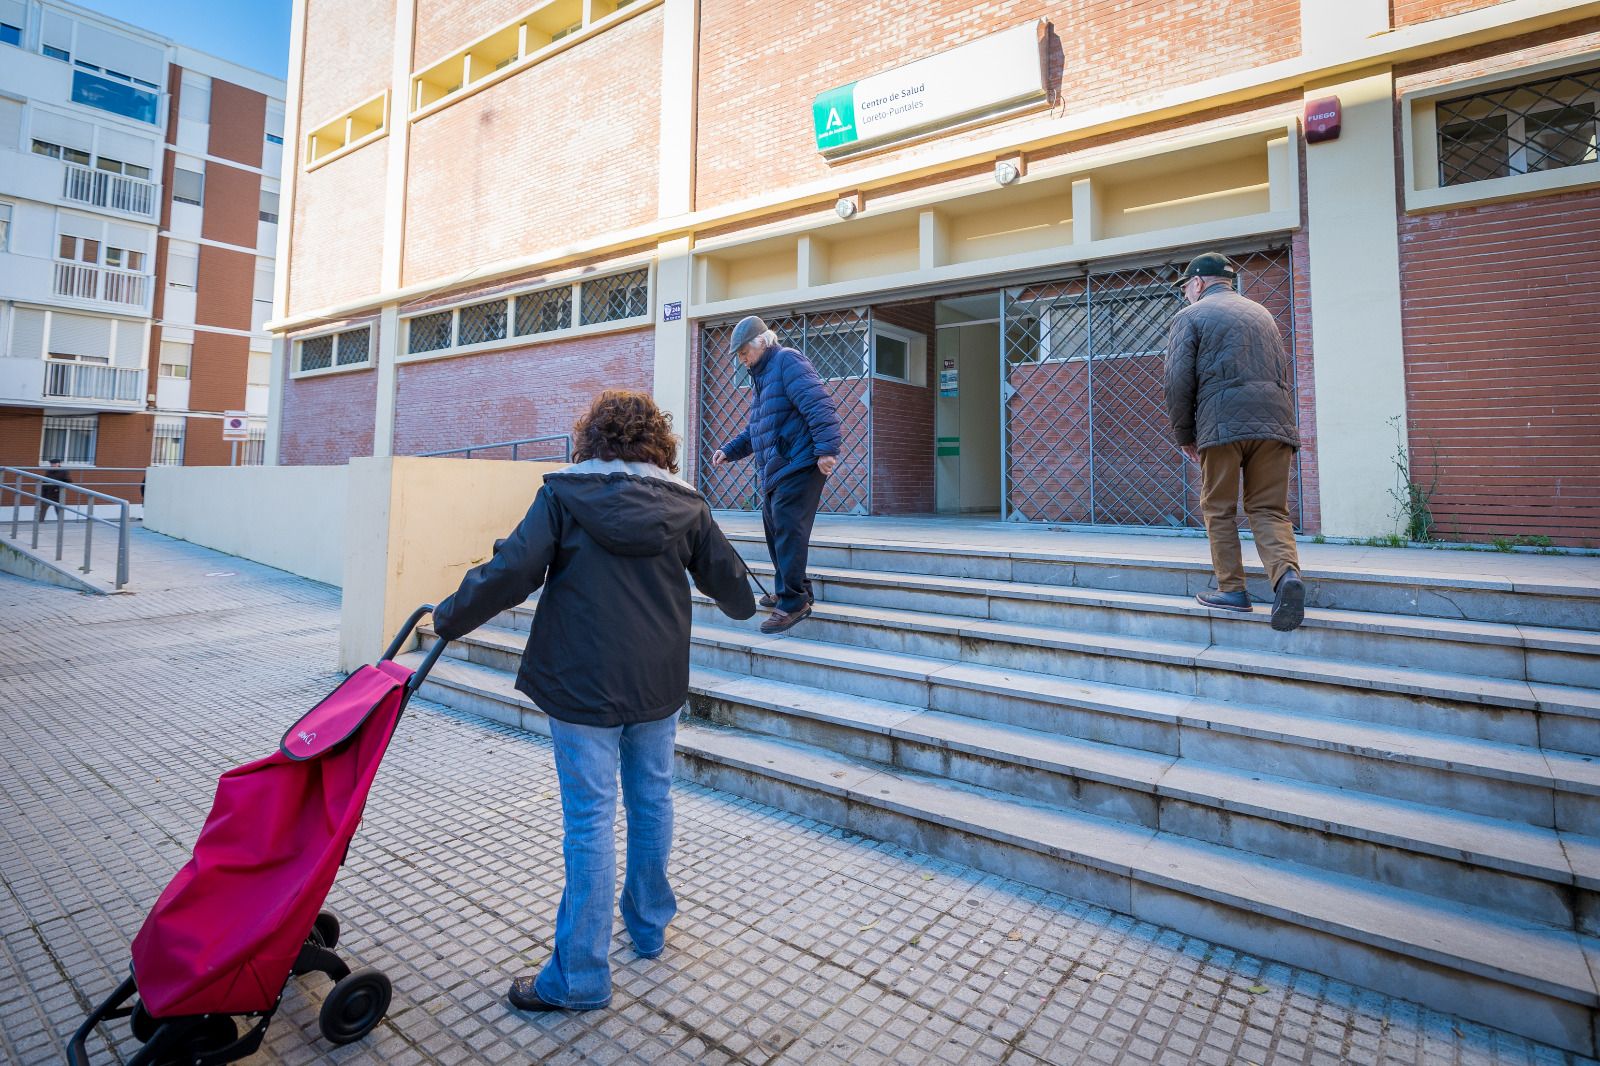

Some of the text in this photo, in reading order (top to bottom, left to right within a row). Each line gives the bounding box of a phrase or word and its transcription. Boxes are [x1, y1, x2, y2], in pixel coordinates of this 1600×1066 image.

[861, 83, 925, 110] Centro de Salud
[863, 101, 924, 124] Loreto-Puntales
[1308, 112, 1335, 122] FUEGO
